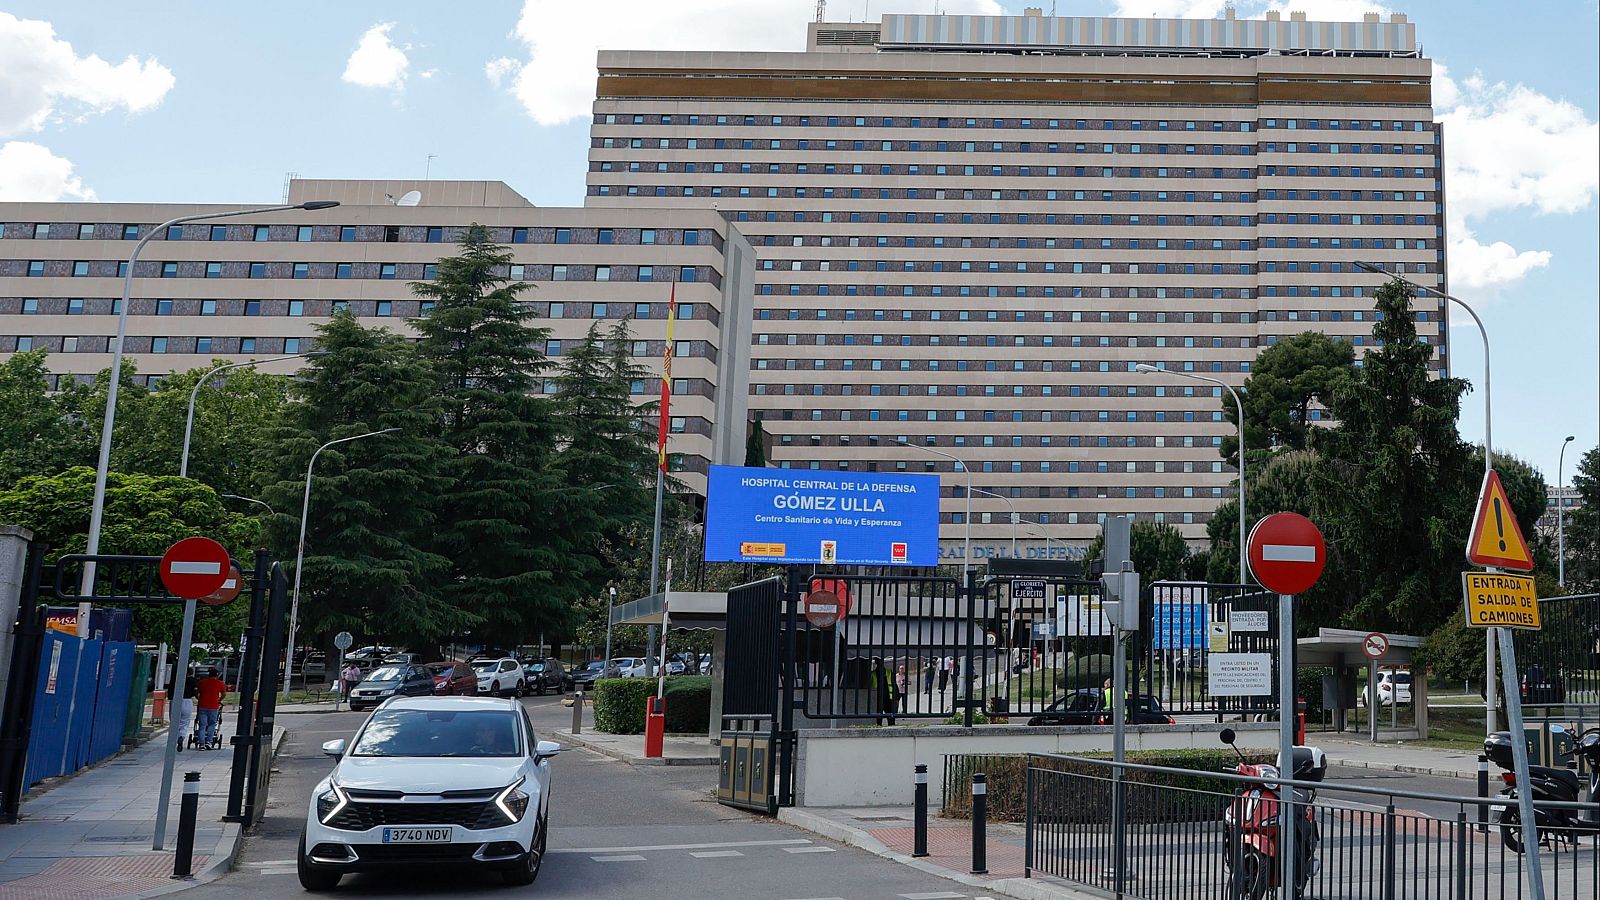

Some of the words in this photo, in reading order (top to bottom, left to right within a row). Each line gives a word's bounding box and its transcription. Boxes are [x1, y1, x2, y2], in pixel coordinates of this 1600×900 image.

[741, 478, 790, 488] HOSPITAL
[793, 480, 839, 490] CENTRAL
[841, 482, 855, 491] DE
[857, 482, 870, 491] LA
[872, 483, 916, 493] DEFENSA
[773, 491, 836, 511] GÓMEZ
[841, 497, 885, 512] ULLA
[755, 514, 783, 523] Centro
[785, 516, 821, 524] Sanitario
[823, 517, 832, 525] de
[854, 519, 859, 527] y
[861, 518, 902, 527] Esperanza
[1473, 578, 1522, 591] ENTRADA
[1525, 582, 1531, 591] Y
[1478, 594, 1517, 606] SALIDA
[1521, 597, 1532, 608] DE
[1479, 611, 1534, 624] CAMIONES
[392, 830, 422, 841] 3740
[426, 830, 449, 841] NDV
